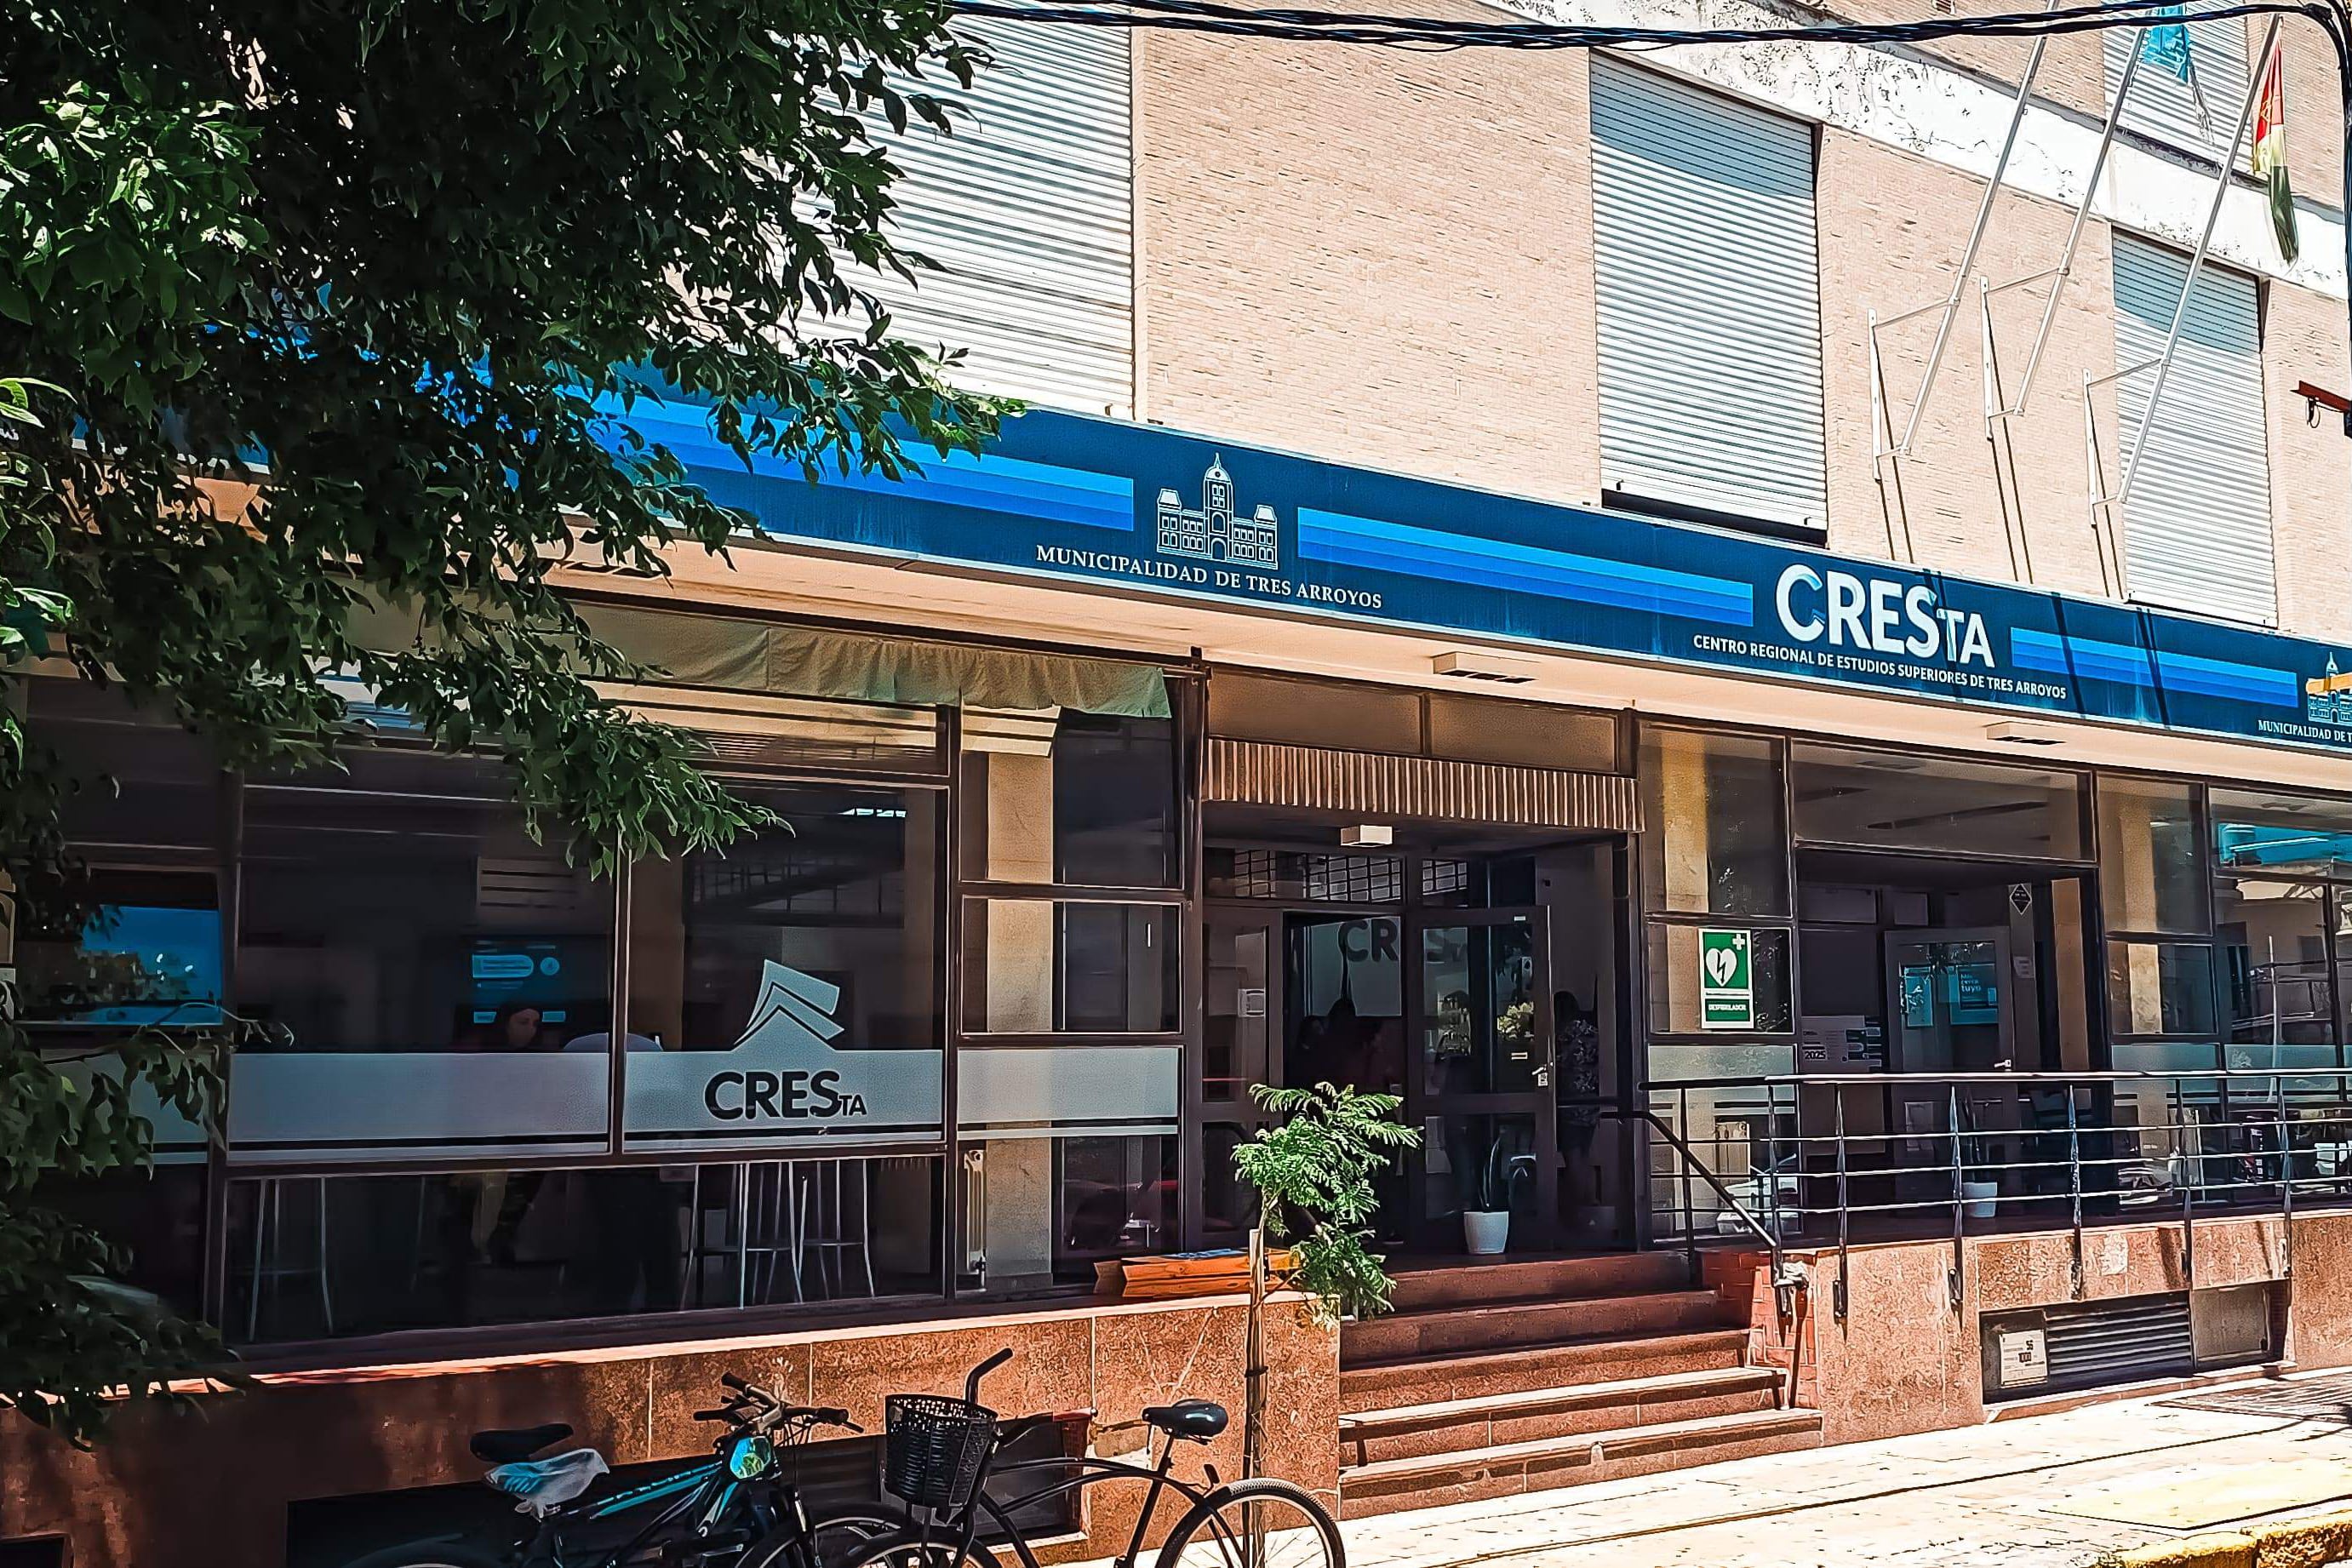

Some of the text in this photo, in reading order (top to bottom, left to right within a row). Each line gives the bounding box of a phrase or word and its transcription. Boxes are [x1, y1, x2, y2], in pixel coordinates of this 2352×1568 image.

[1036, 545, 1382, 609] MUNICIPALIDAD DE TRES ARROYOS
[1776, 564, 1995, 668] CRESTA
[1693, 634, 2067, 700] CENTRO REGIONAL DE ESTUDIOS SUPERIORES DE TRES ARROYOS
[2258, 719, 2332, 740] MUNICIPALIDAD
[2333, 730, 2346, 742] DE
[1805, 1050, 1826, 1061] 2025
[704, 1070, 867, 1121] CRESTA
